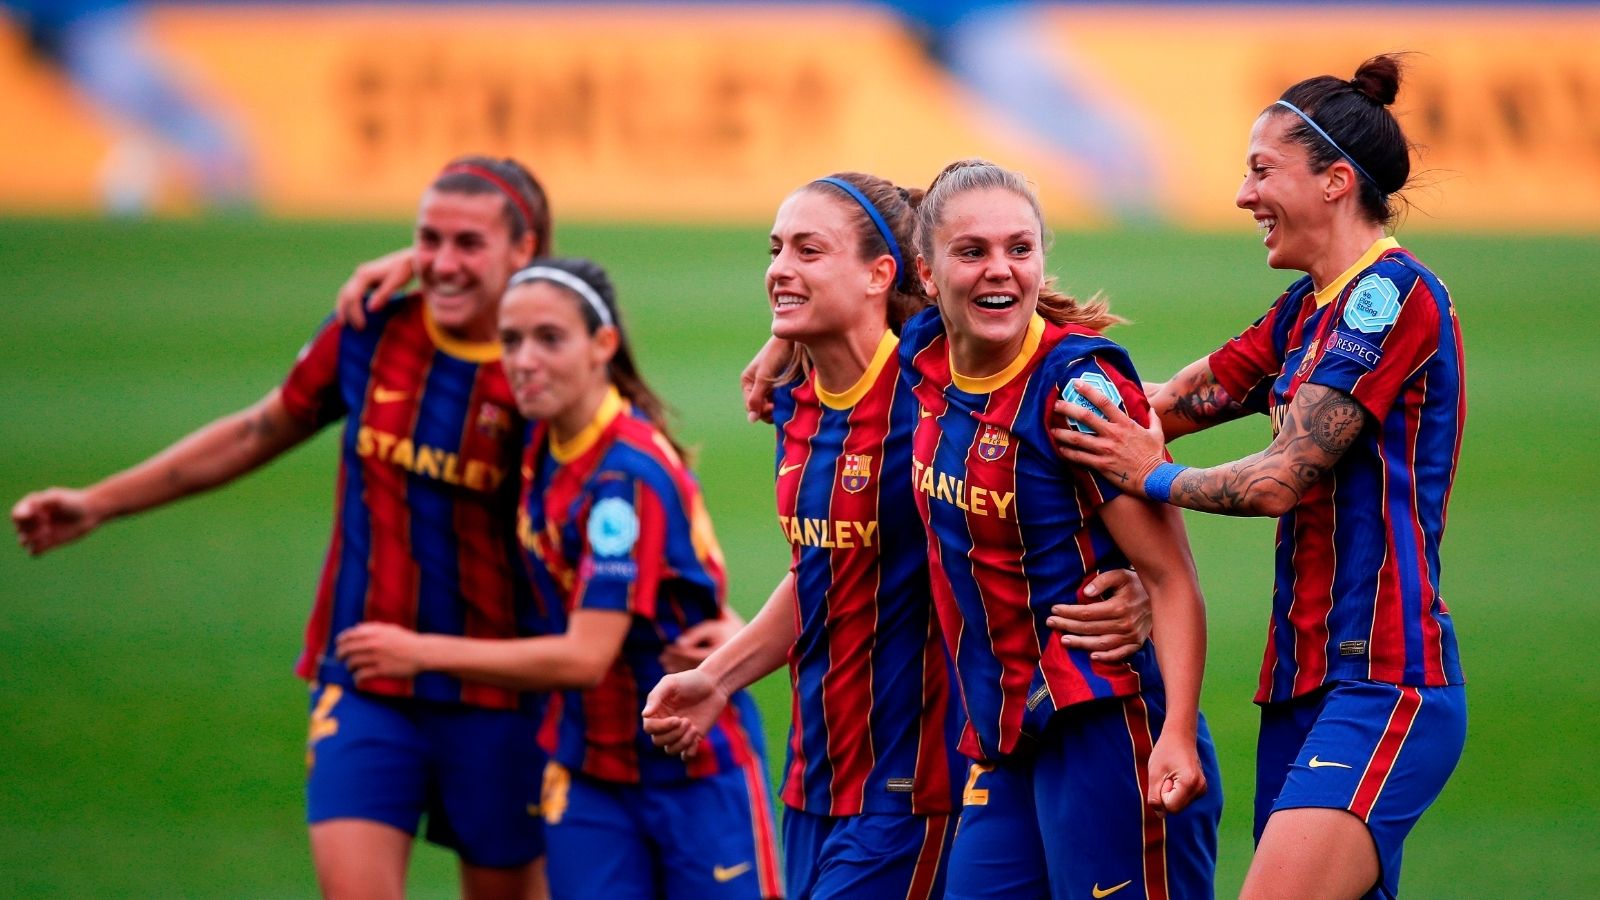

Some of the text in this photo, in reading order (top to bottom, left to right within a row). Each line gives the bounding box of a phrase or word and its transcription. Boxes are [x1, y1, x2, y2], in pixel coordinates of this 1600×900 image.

[1336, 338, 1380, 364] RESPECT
[356, 426, 502, 490] STANLEY
[911, 456, 1015, 519] TANLEY
[779, 515, 878, 548] TANLEY
